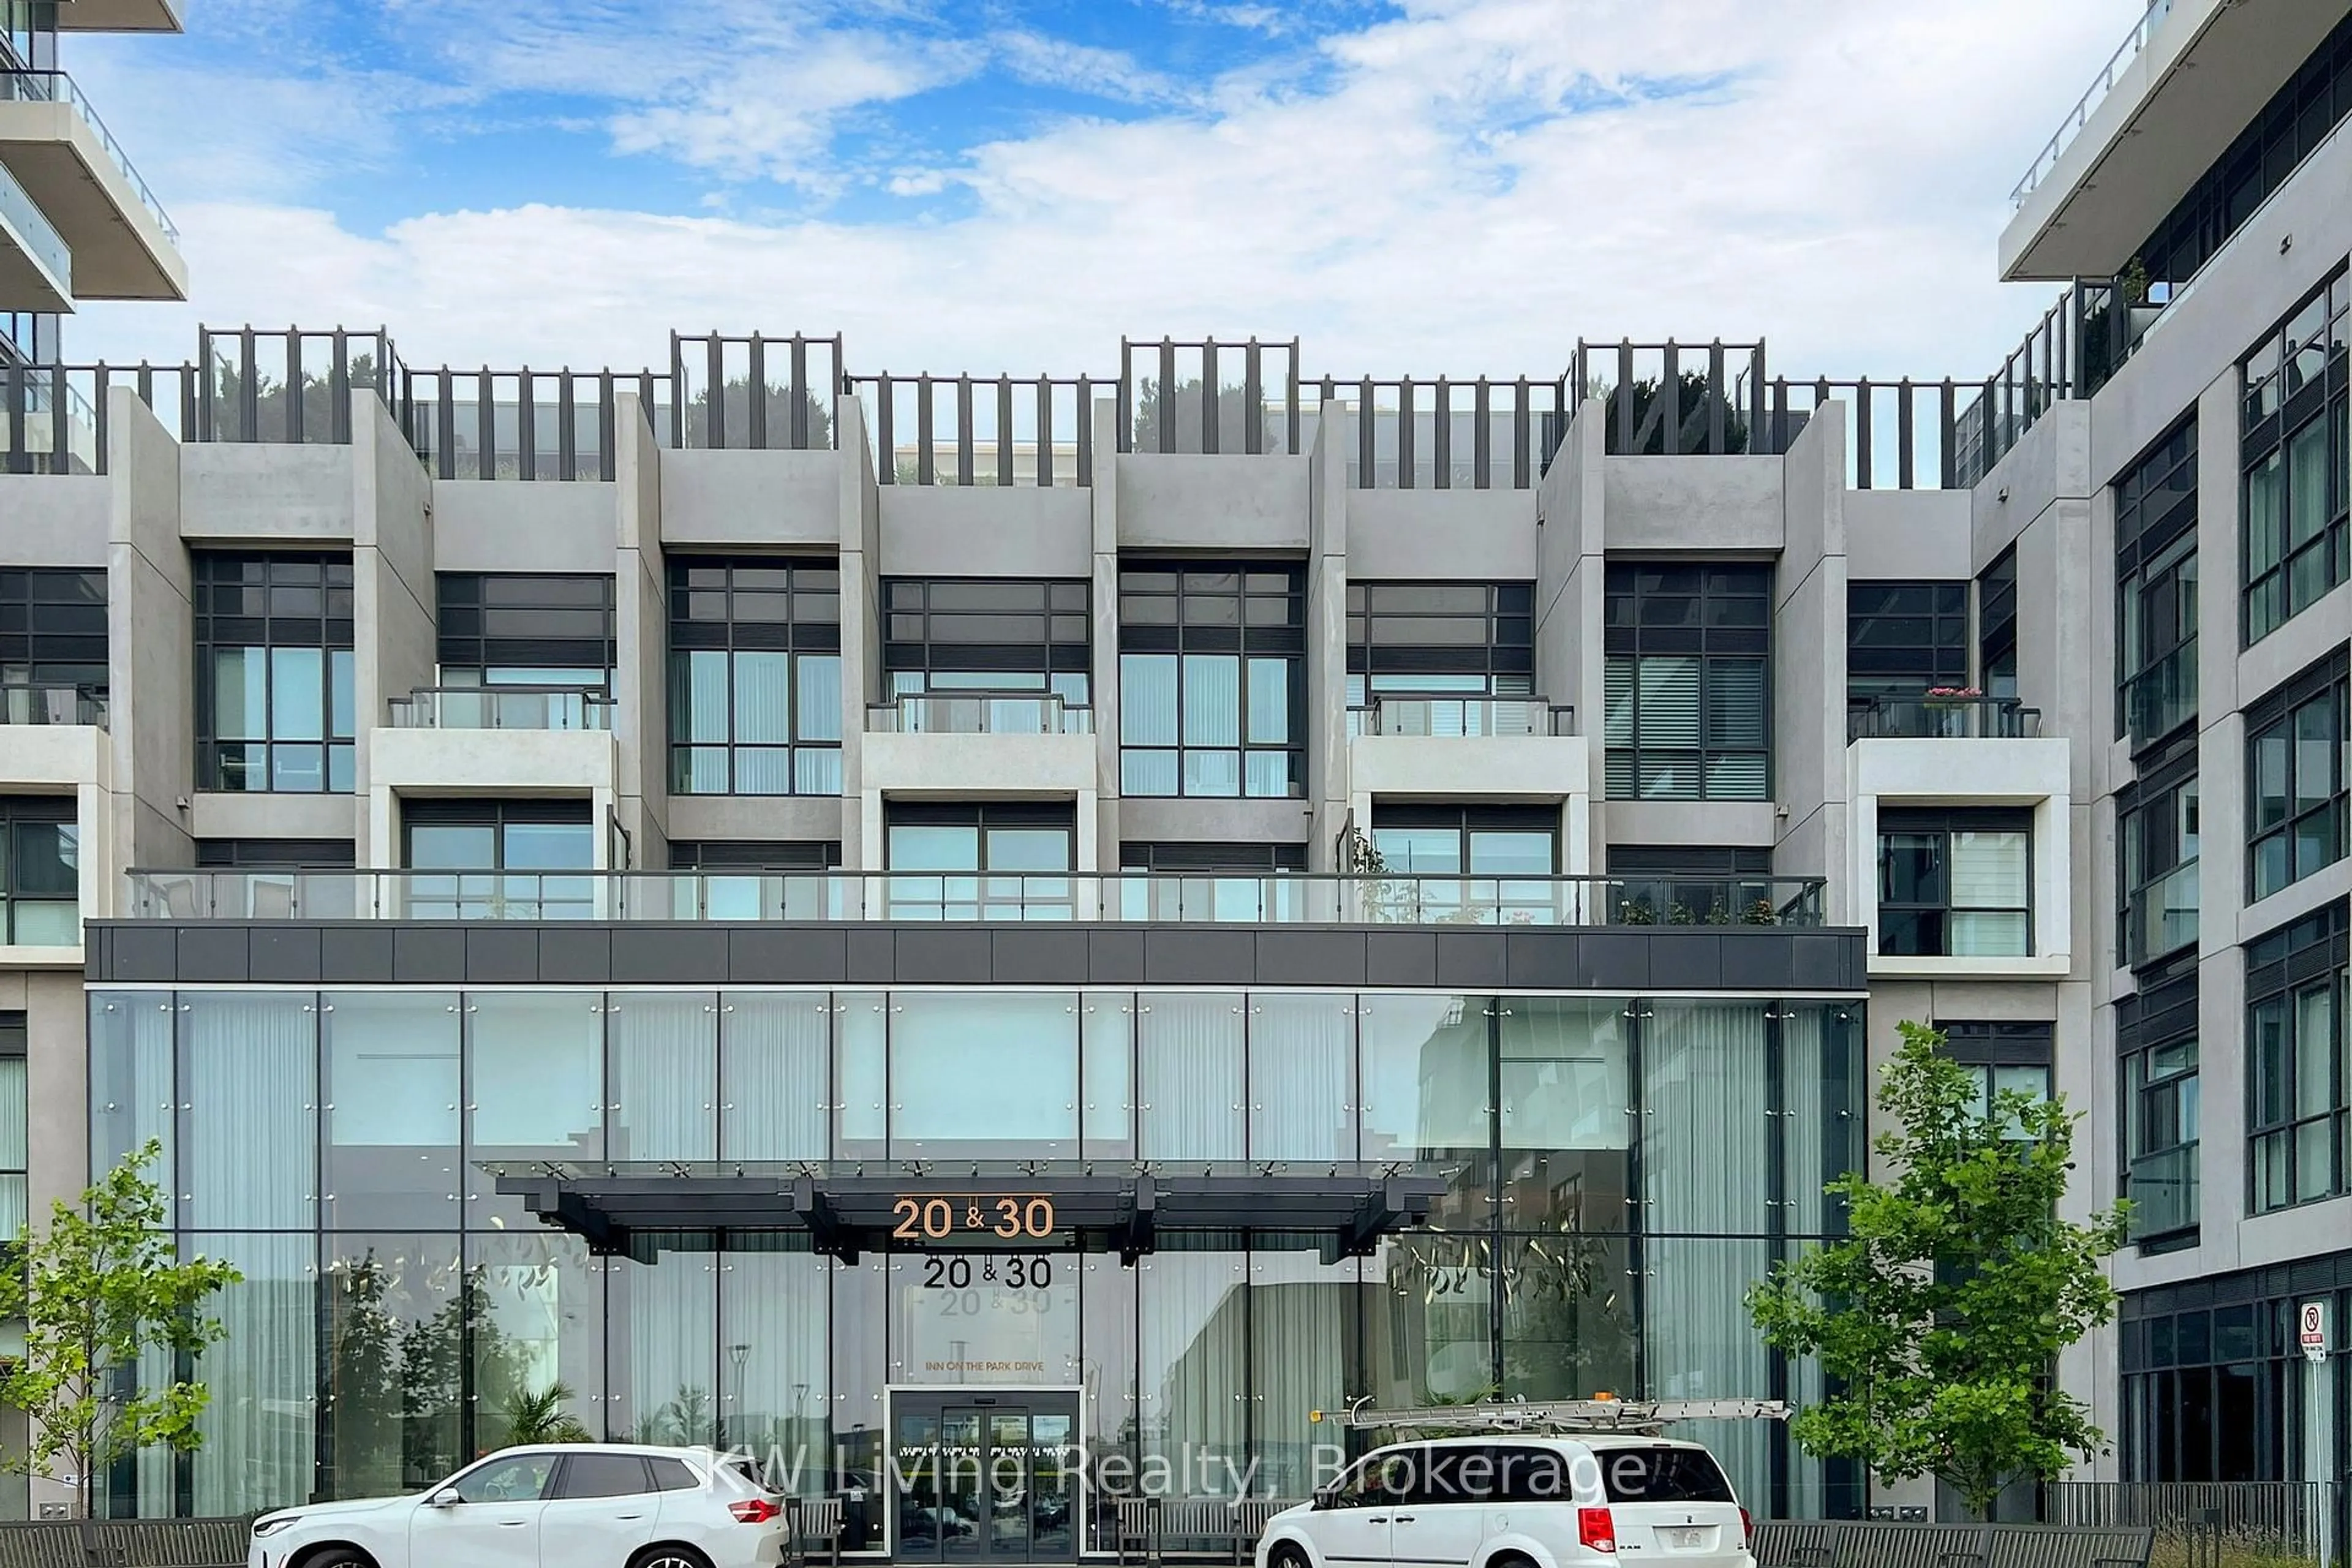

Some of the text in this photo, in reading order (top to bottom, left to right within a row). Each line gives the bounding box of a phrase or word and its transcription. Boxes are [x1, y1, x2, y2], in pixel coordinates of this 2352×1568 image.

[892, 1199, 1054, 1238] 20 & 30
[923, 1257, 1051, 1289] 20 & 30
[940, 1289, 980, 1316] 20
[925, 1362, 1044, 1372] INN ON THE PARK DRIVE
